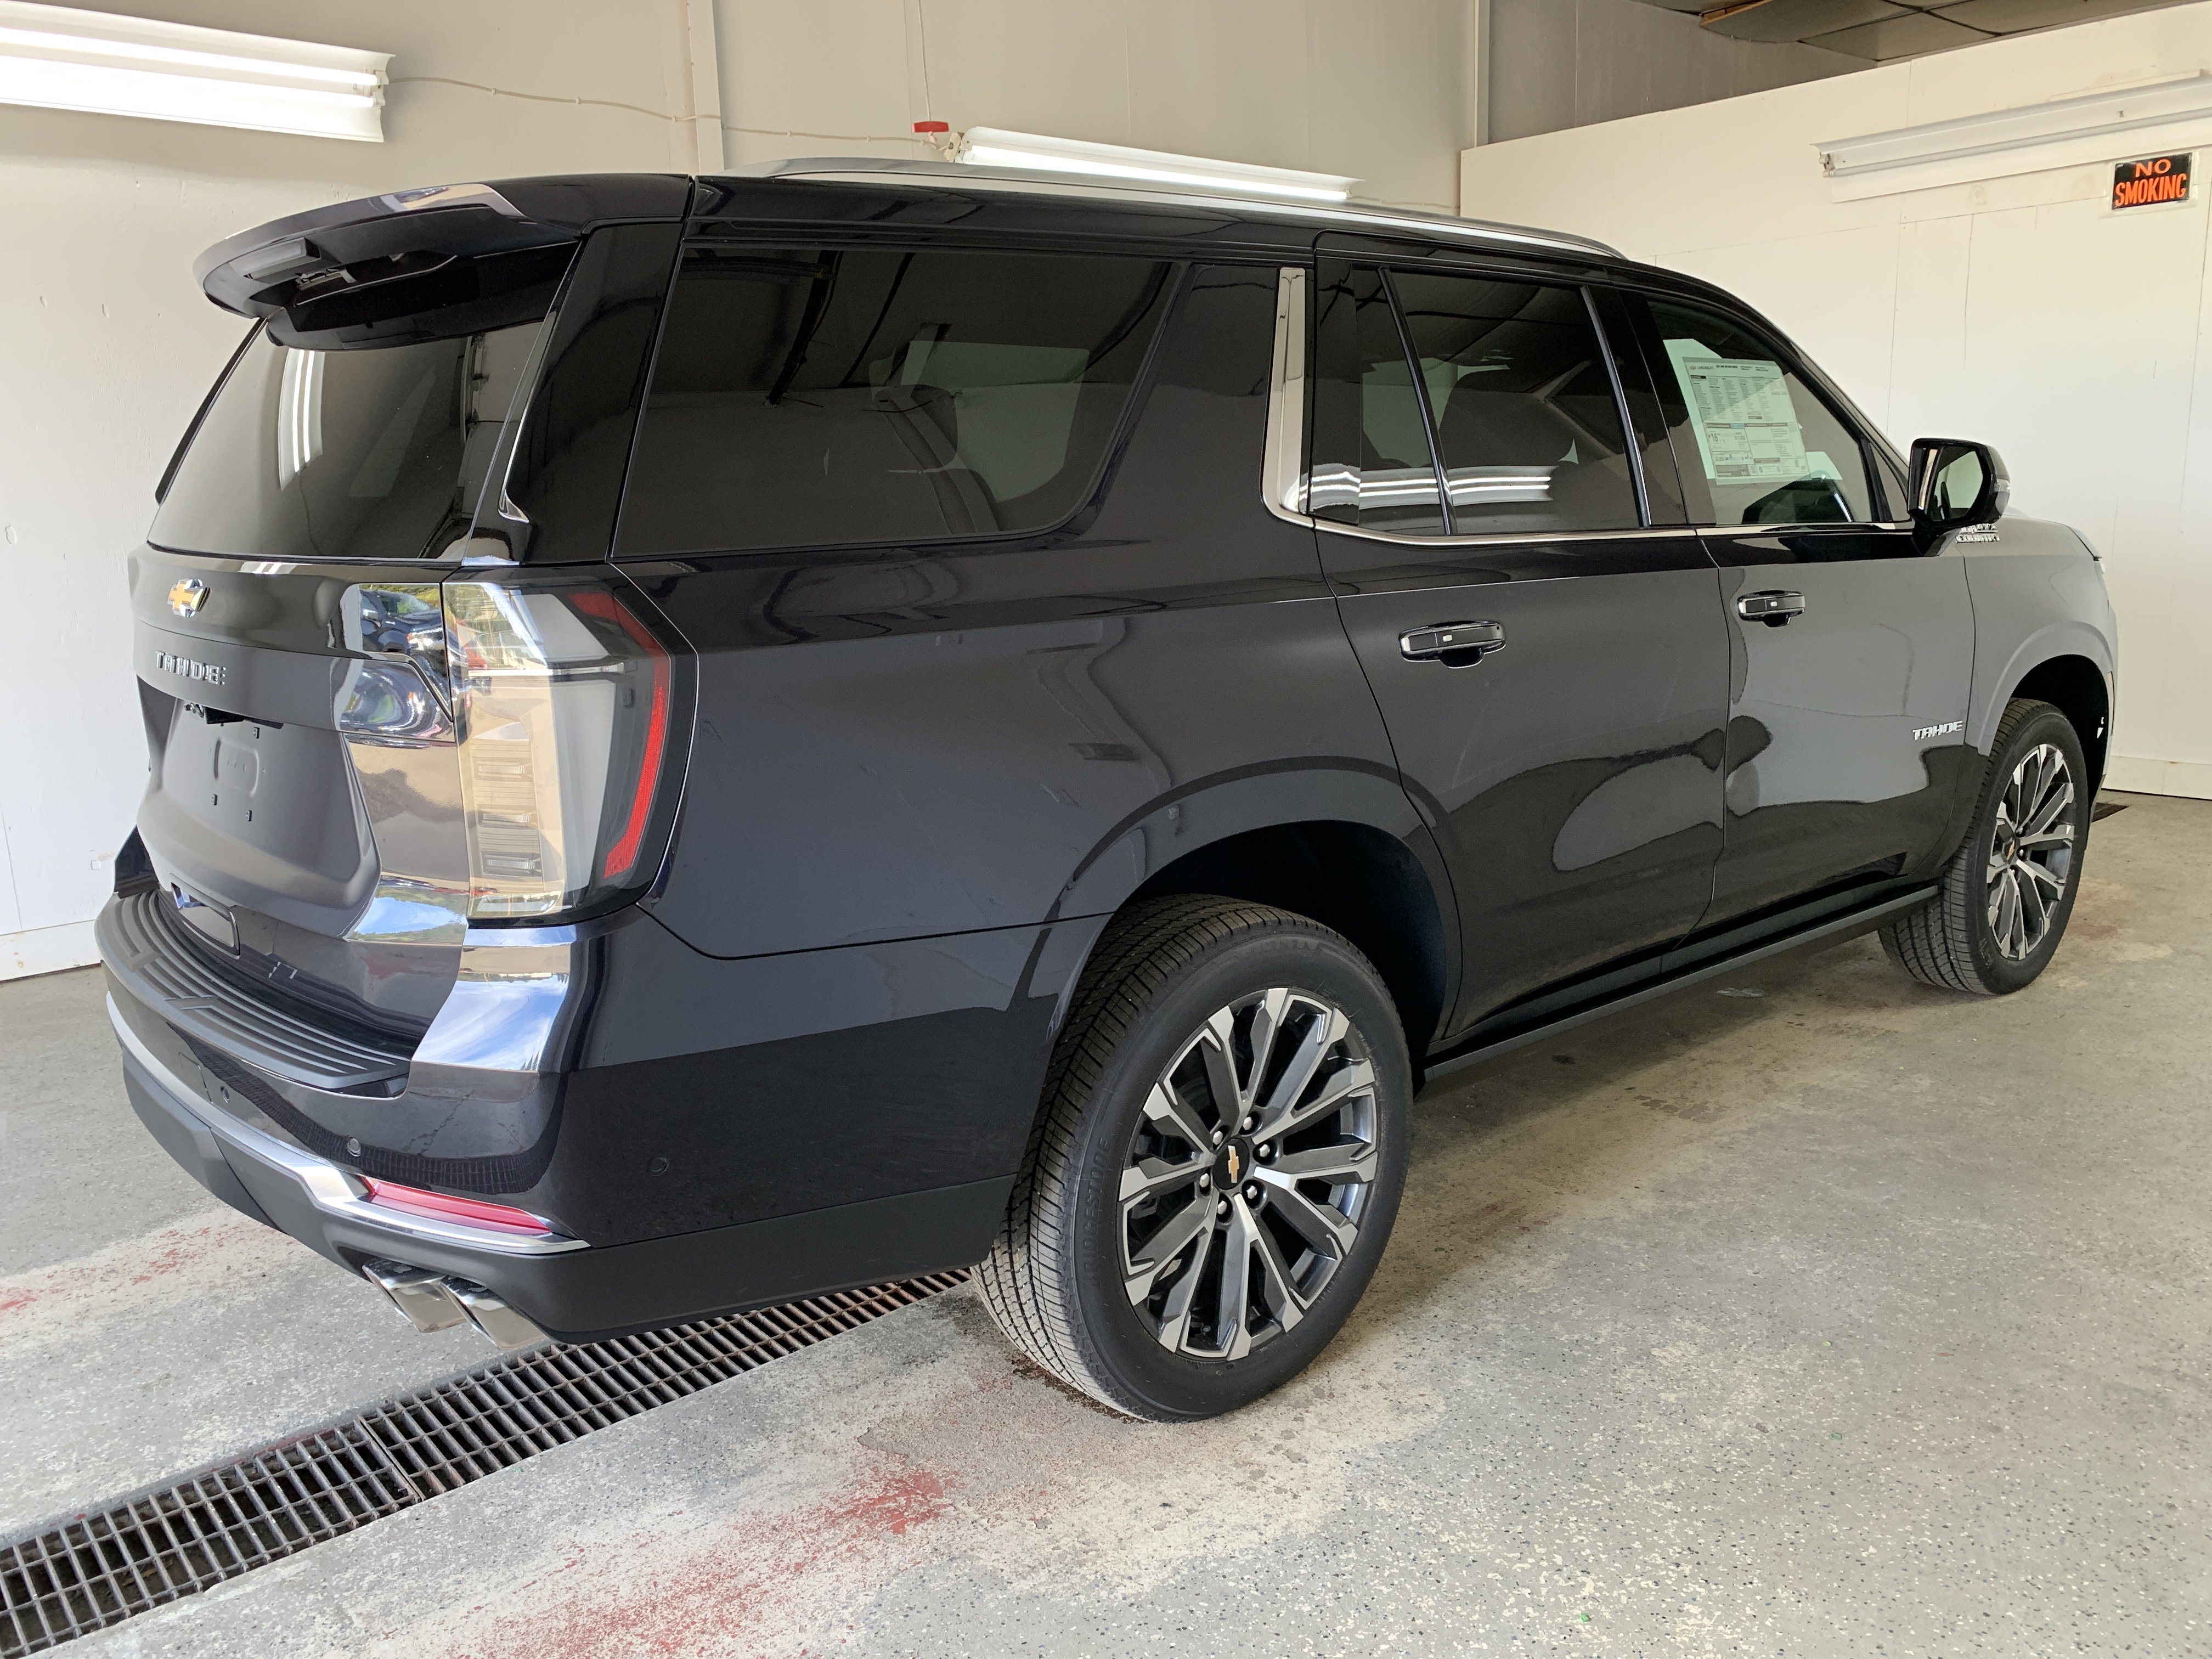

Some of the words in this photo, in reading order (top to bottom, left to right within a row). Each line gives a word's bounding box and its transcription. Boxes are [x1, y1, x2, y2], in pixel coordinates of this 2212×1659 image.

[2135, 159, 2171, 177] NO
[2115, 173, 2187, 207] SMOKING
[1955, 533, 2000, 543] COUNTRY
[155, 650, 226, 685] TAHOE
[1912, 720, 1962, 741] TAHOE
